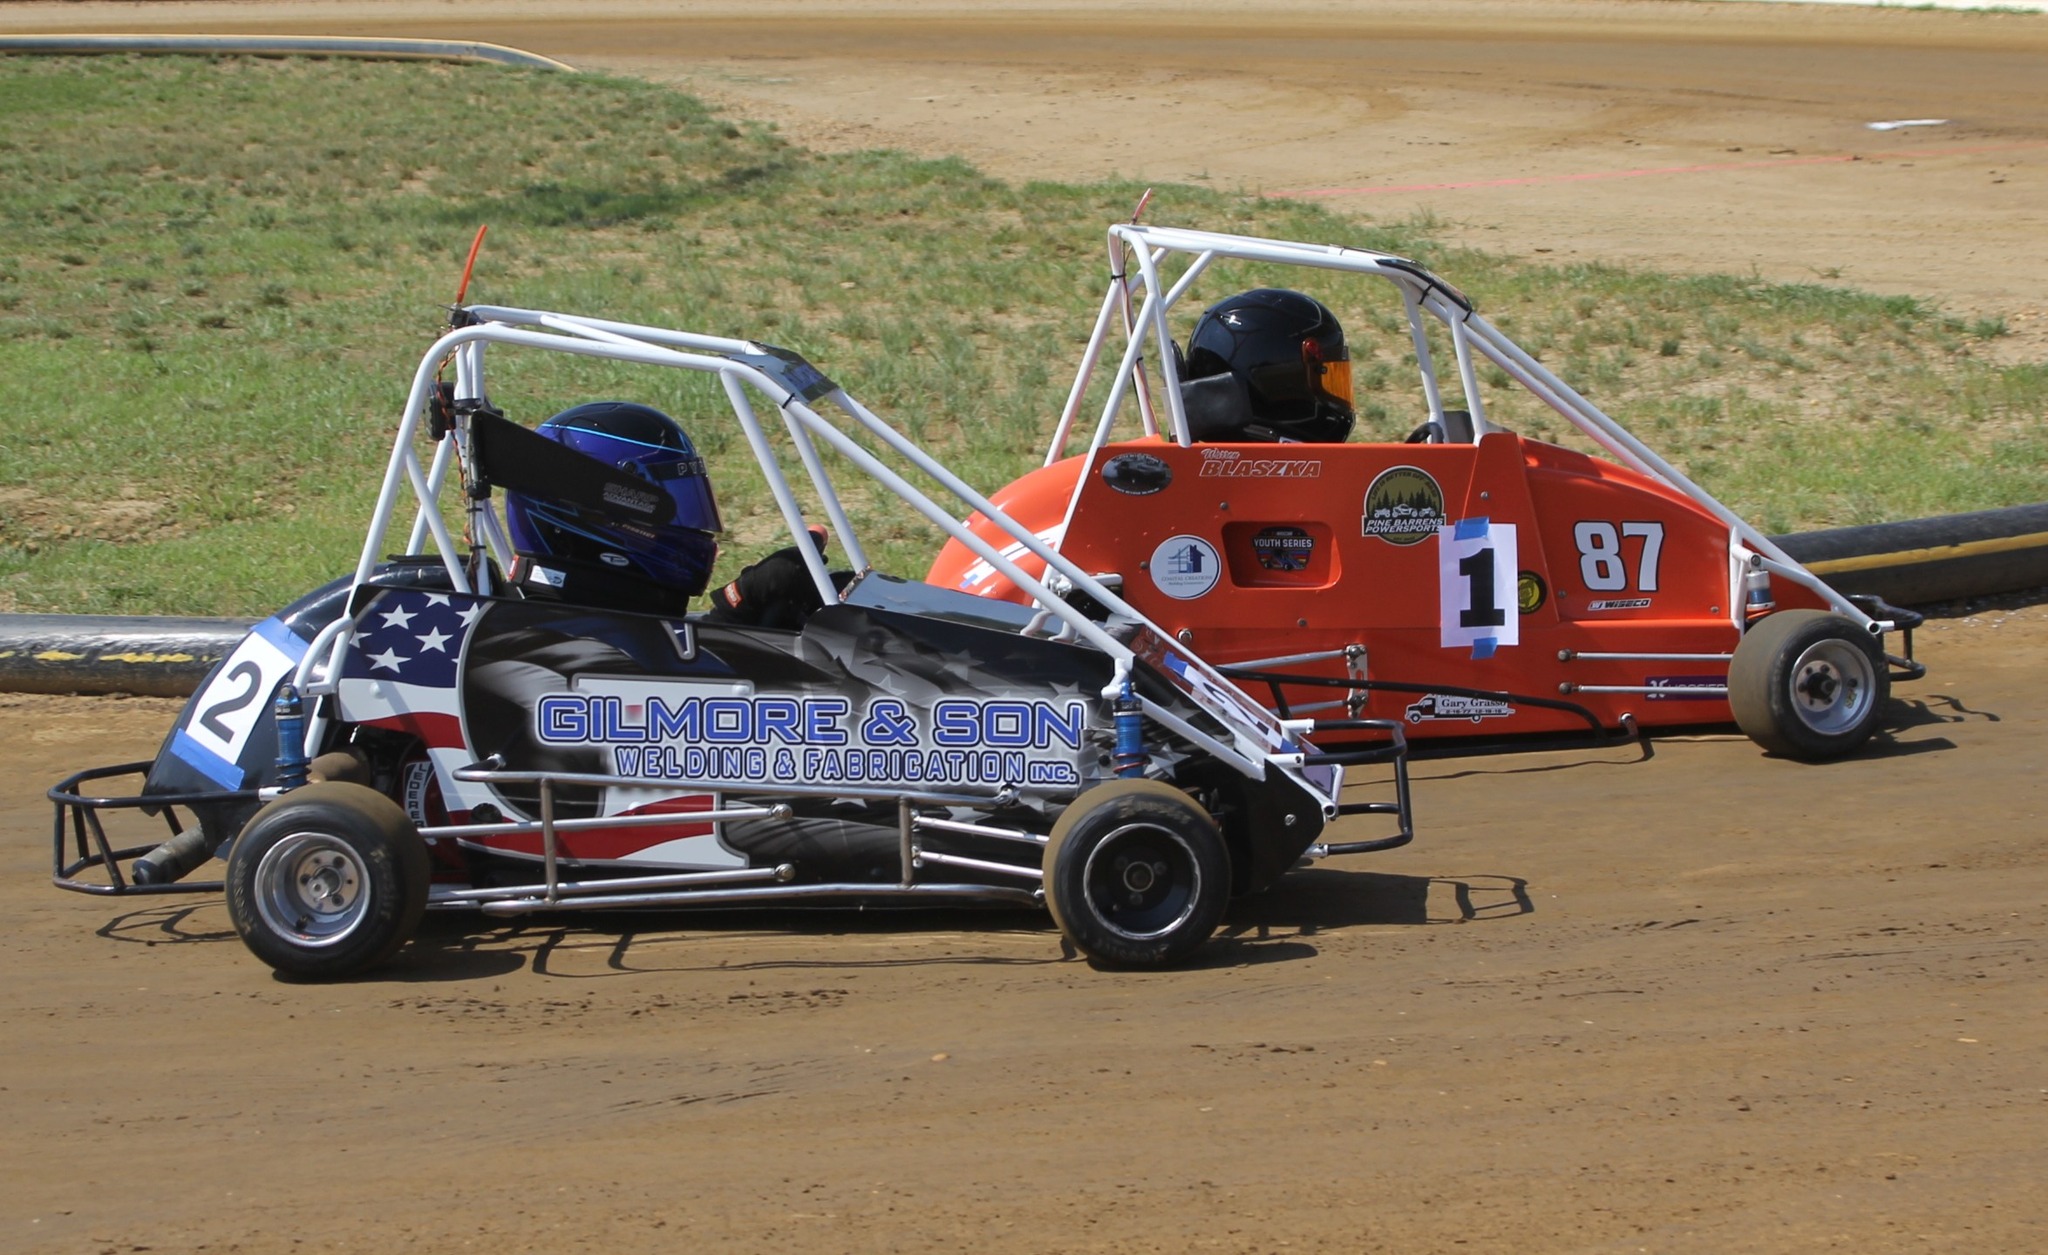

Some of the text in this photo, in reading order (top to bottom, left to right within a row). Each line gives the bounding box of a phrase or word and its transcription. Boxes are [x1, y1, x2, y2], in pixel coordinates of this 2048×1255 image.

[1199, 460, 1321, 477] BLASZKA
[1367, 518, 1443, 527] PINE BARRENS
[1254, 539, 1312, 548] YOUTH SERIES
[1574, 520, 1665, 591] 87
[1459, 547, 1505, 628] 1
[1605, 600, 1650, 608] WISECO
[200, 660, 263, 744] 2
[1441, 699, 1467, 709] Gary
[540, 696, 1084, 749] GILMORE & SON
[615, 746, 1080, 785] WELDING & FABRICATION INC.
